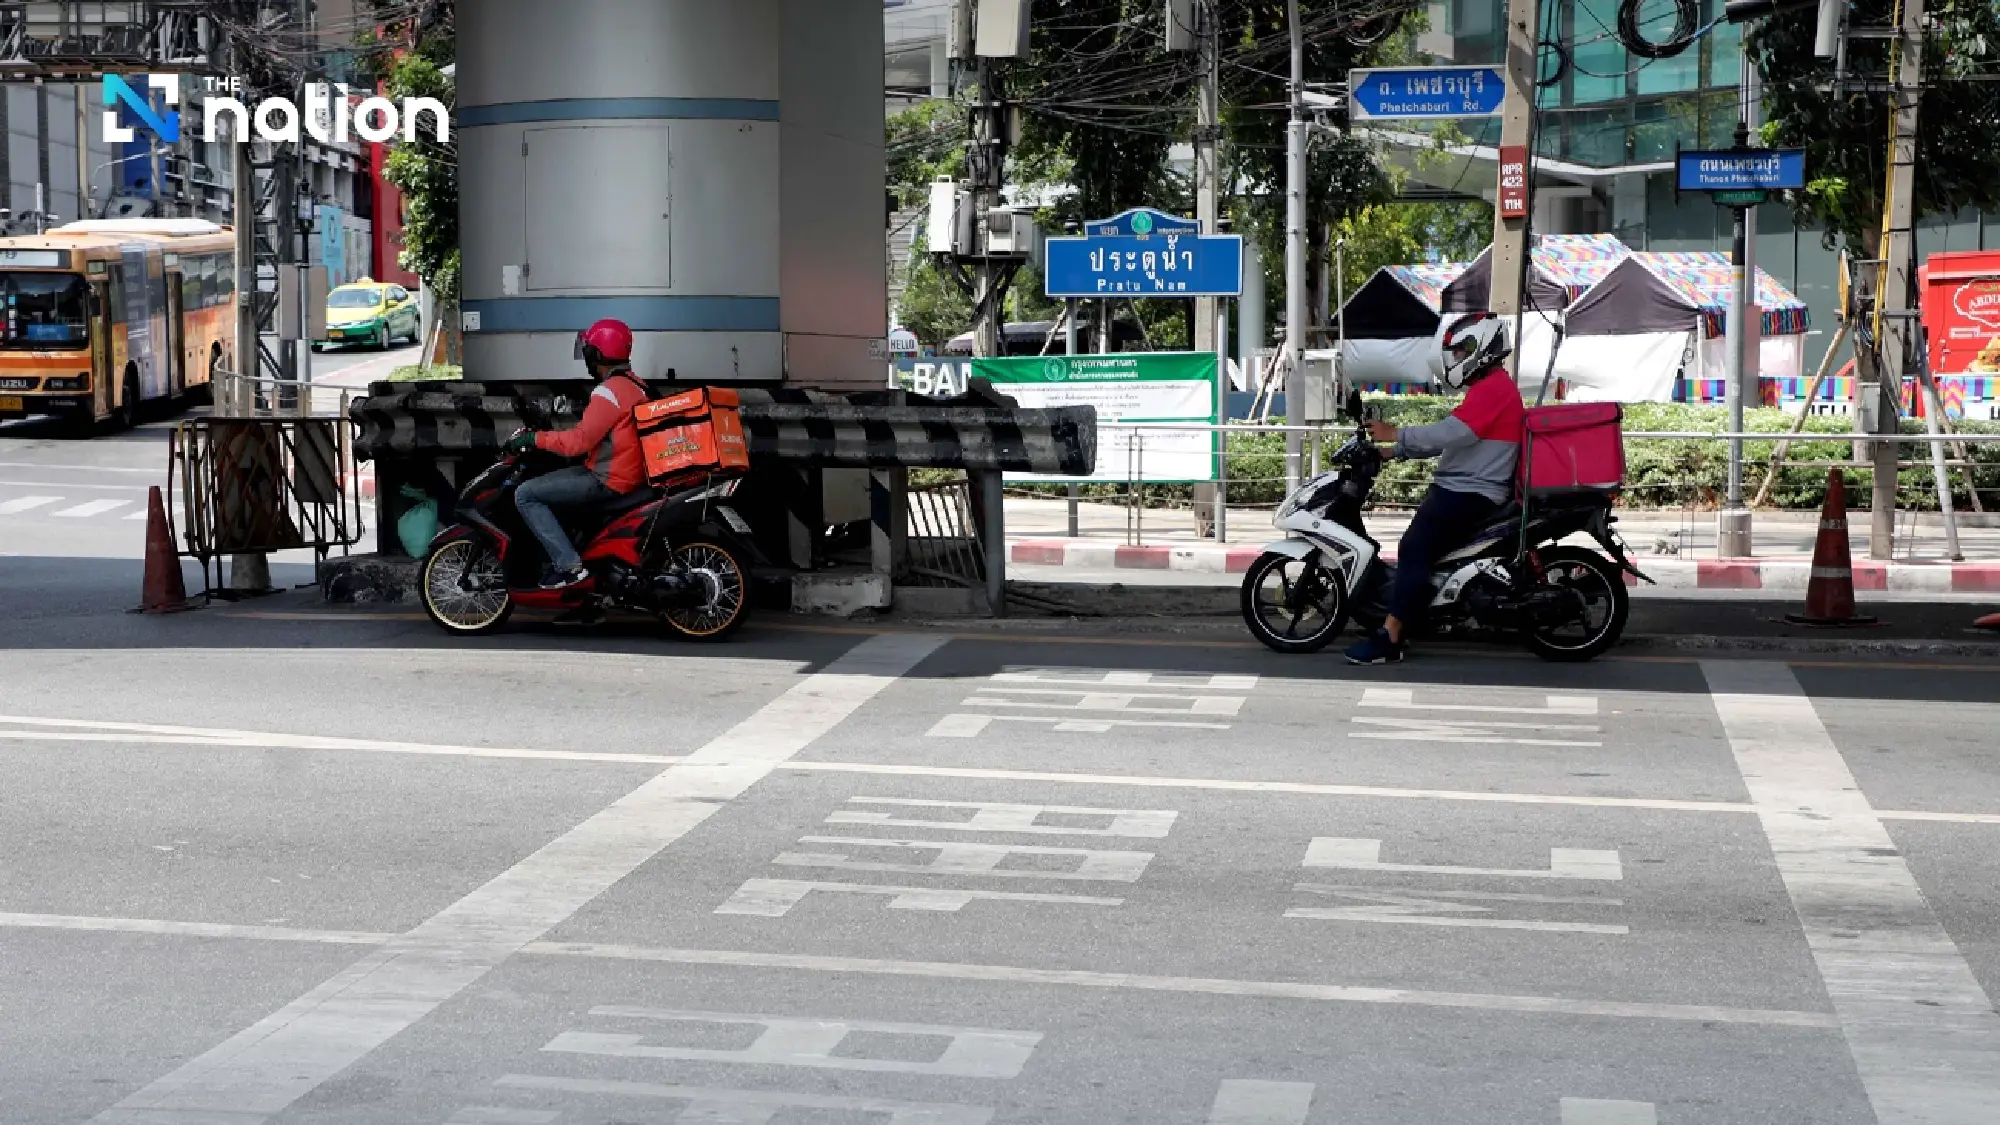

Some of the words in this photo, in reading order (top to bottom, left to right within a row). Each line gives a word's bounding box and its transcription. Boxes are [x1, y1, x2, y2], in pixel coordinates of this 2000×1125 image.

[1407, 71, 1484, 99] เพชรบุรี
[1379, 102, 1450, 112] Phetchaburi
[1463, 101, 1484, 112] Rd.
[1501, 163, 1523, 175] RPR
[1089, 234, 1193, 280] ประตูน้ำ
[1097, 278, 1141, 292] Pratu
[1154, 278, 1187, 292] Nam
[890, 338, 915, 351] HELLO
